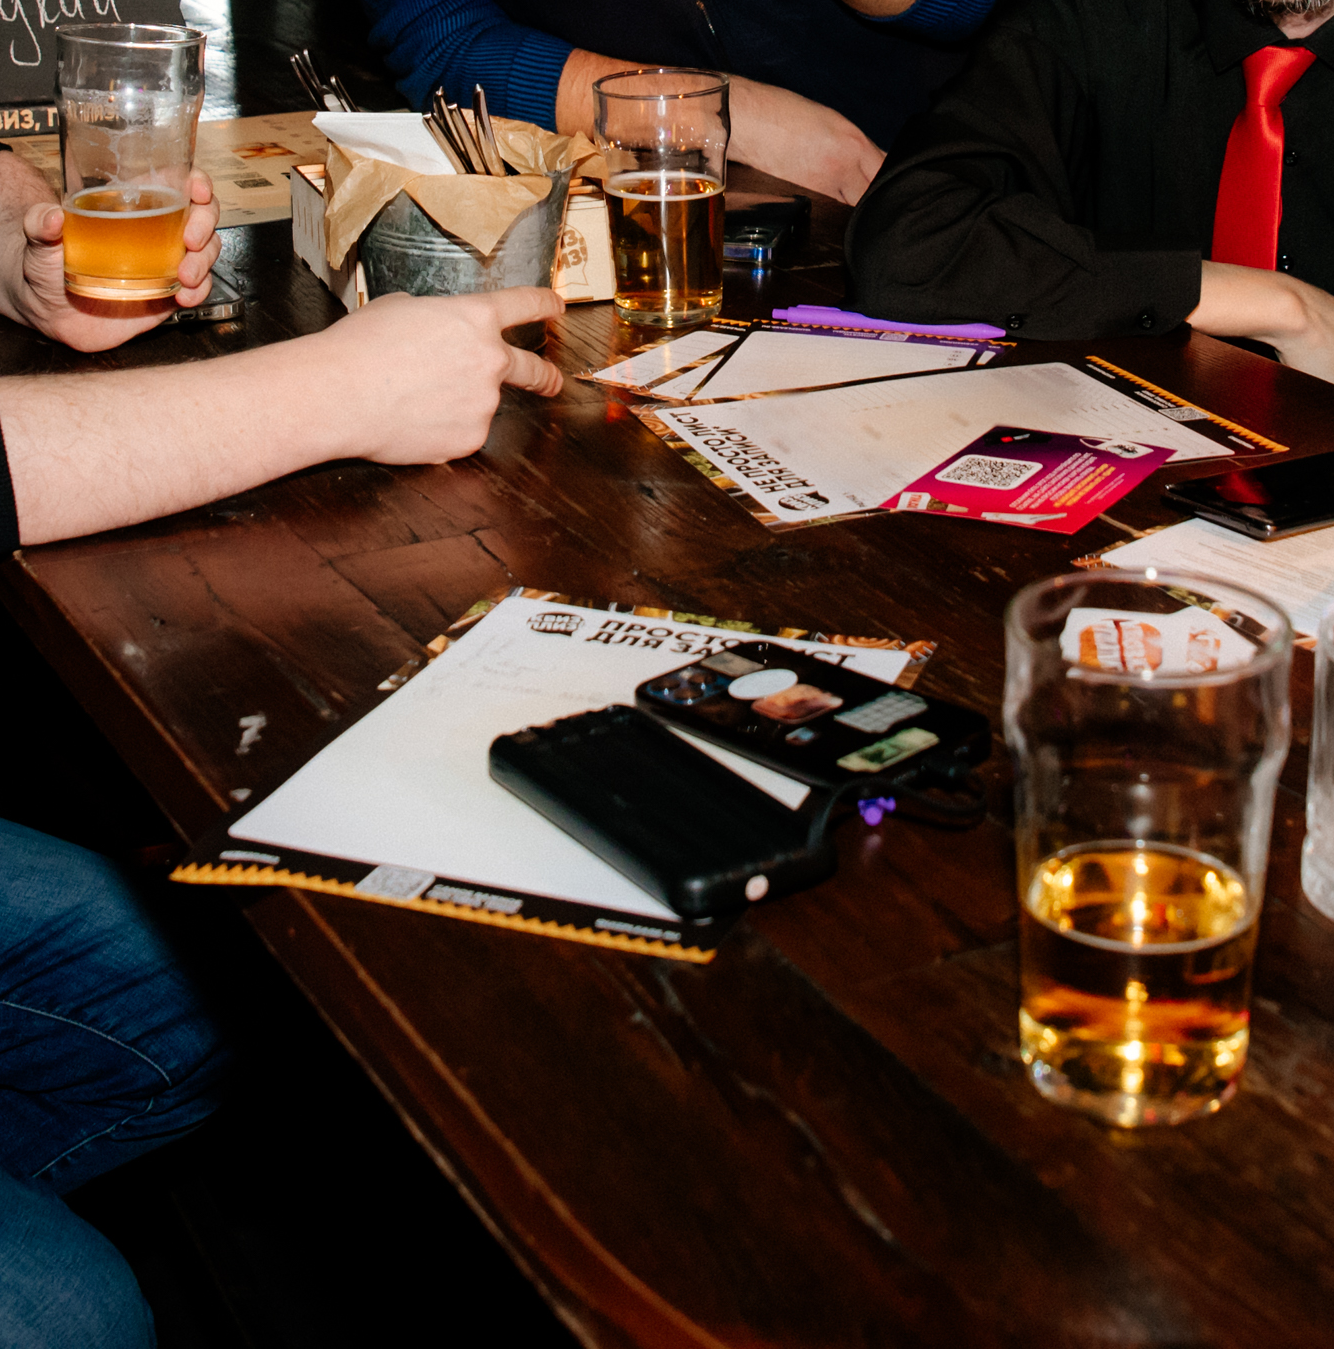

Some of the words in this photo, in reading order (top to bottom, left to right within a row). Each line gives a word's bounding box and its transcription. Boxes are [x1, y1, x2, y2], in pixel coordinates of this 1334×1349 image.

[669, 411, 716, 437] ЛИСТ
[703, 437, 762, 479] ПРОСТО
[752, 479, 786, 493] НЕ
[768, 467, 815, 489] ДЛЯ
[585, 631, 664, 650] ДЛЯ
